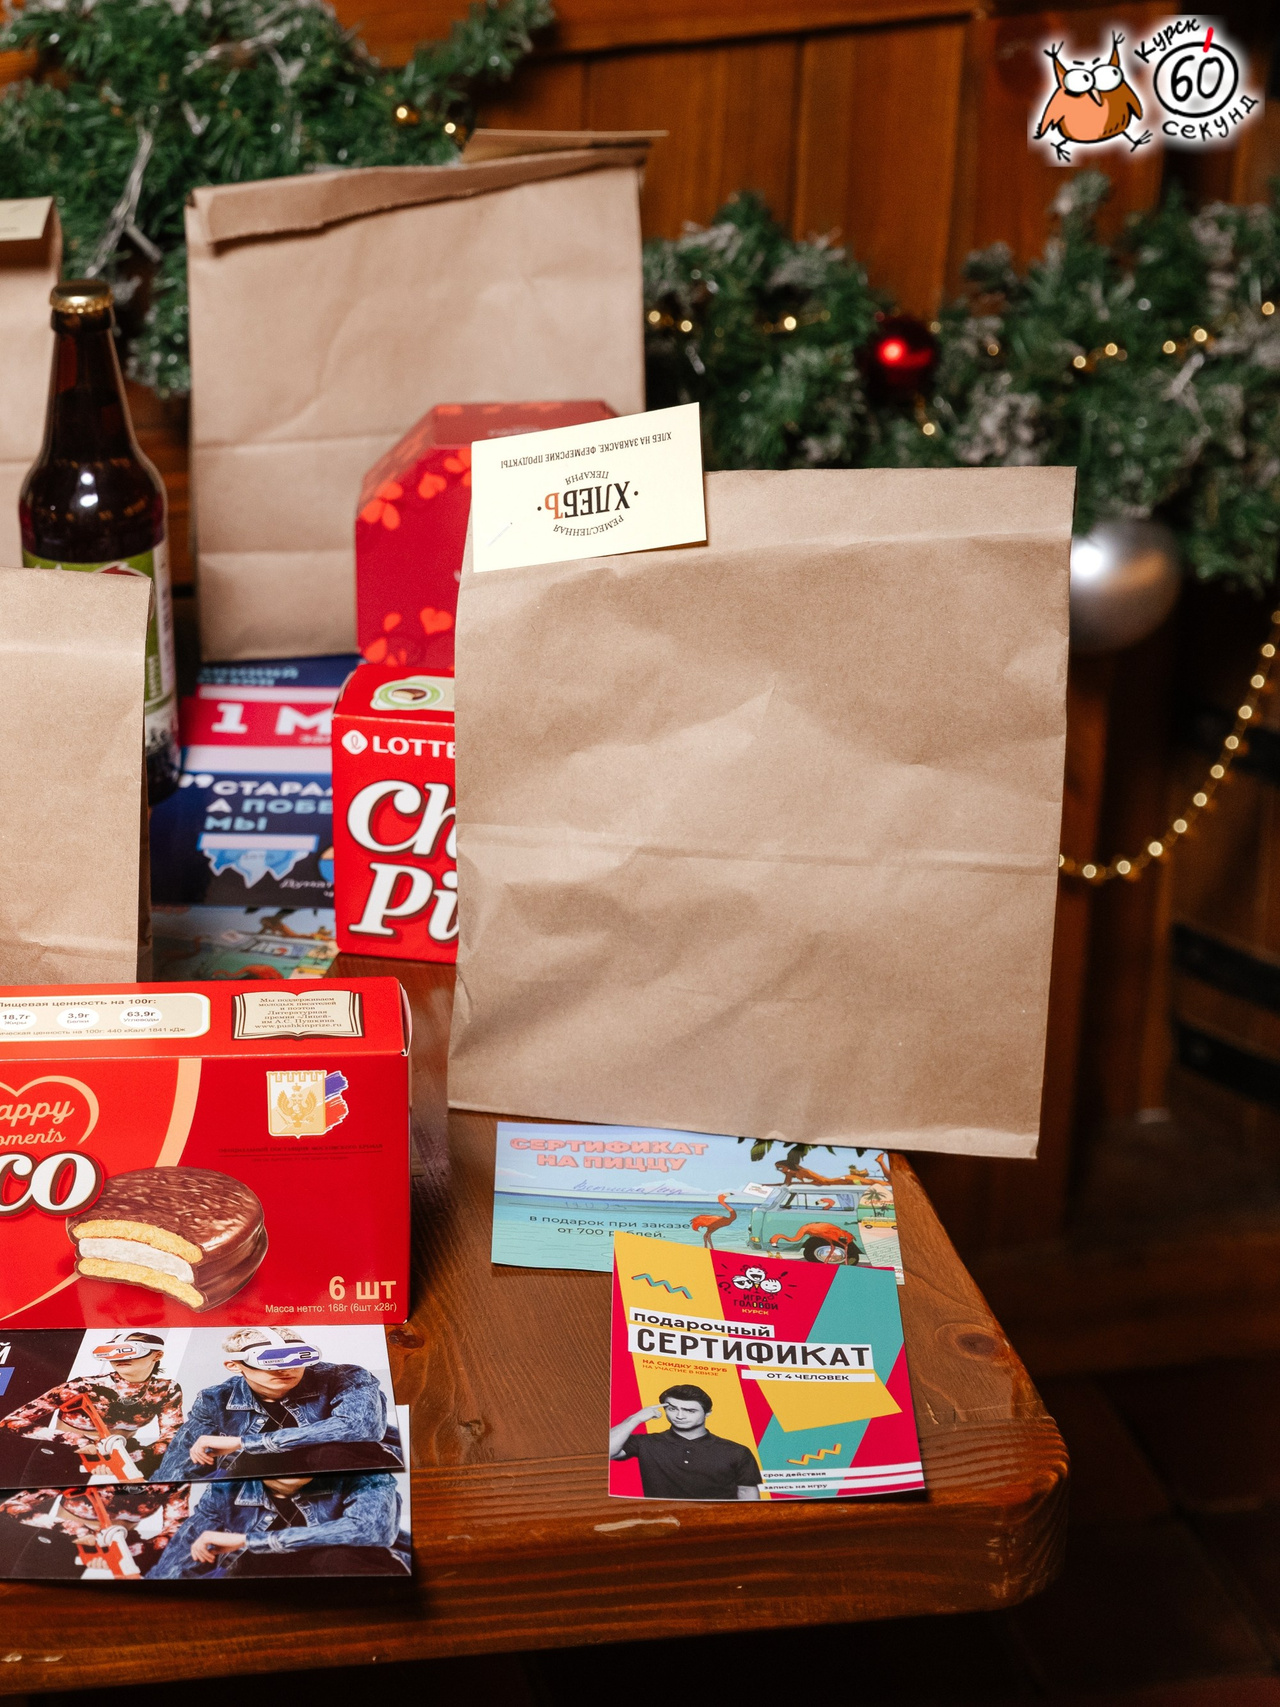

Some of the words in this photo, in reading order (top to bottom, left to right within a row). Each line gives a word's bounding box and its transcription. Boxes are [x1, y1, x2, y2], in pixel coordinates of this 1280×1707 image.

[640, 435, 650, 446] НА
[652, 431, 672, 444] ХЛЕБ
[545, 446, 596, 462] ФЕРМЕРСКИЕ
[500, 455, 544, 469] ПРОДУКТЫ
[565, 470, 610, 486] ПЕКАРНЯ
[544, 481, 630, 520] ХЛЕБЪ
[553, 514, 624, 537] РЕМЕСЛЕННАЯ
[204, 817, 268, 831] МЫ
[510, 1136, 709, 1156] СЕРТИФИКАТ
[536, 1154, 579, 1168] НА
[584, 1156, 688, 1173] ПИЦЦУ
[542, 1216, 605, 1226] подарок
[609, 1221, 637, 1229] при
[328, 1276, 346, 1300] 6
[743, 1294, 768, 1302] ИГРА
[265, 1304, 294, 1313] Масса
[328, 1304, 348, 1312] 168г
[633, 1312, 771, 1337] подарочный
[637, 1328, 870, 1366] СЕРТИФИКАТ
[654, 1366, 687, 1374] УЧАСТИЕ
[657, 1361, 691, 1370] СКИДКУ
